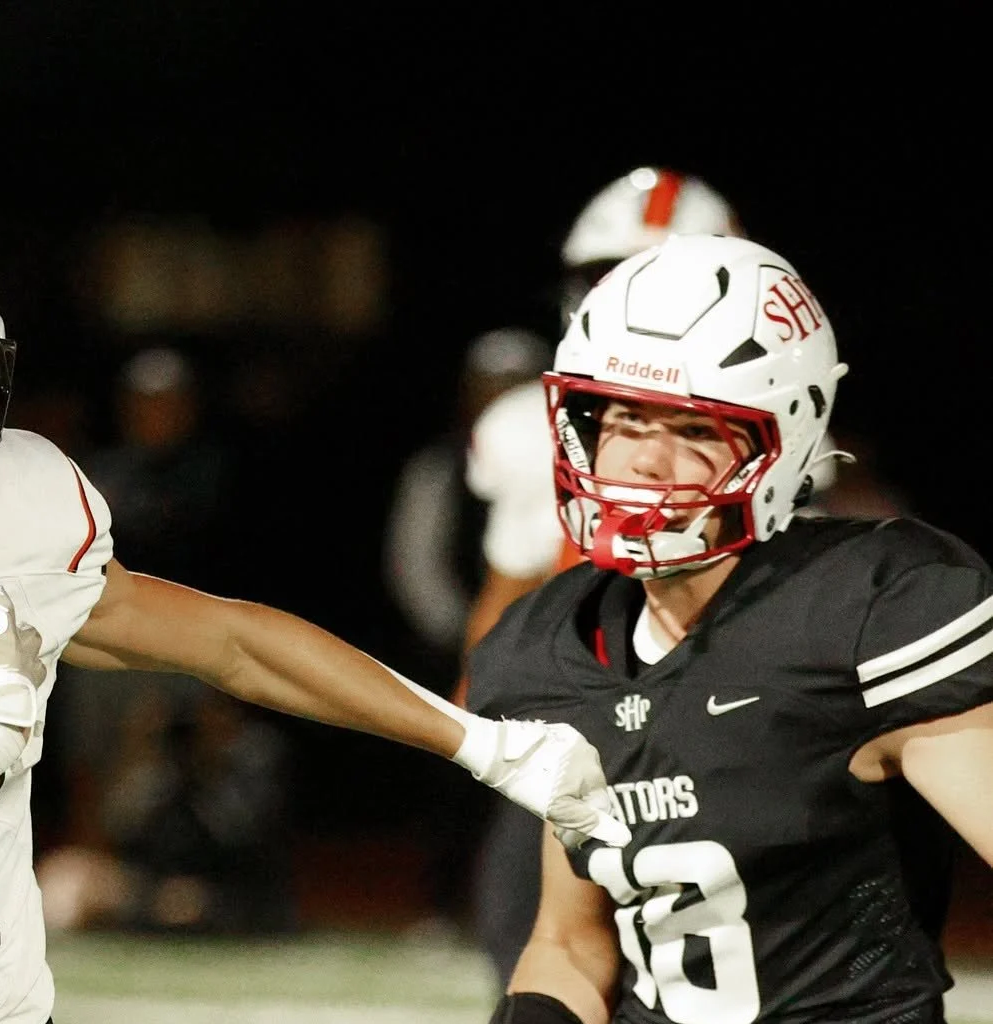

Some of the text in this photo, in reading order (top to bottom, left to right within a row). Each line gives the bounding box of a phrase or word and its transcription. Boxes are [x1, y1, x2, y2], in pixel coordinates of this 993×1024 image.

[607, 356, 680, 384] Riddell
[615, 694, 651, 732] SHP
[606, 775, 699, 825] ATORS
